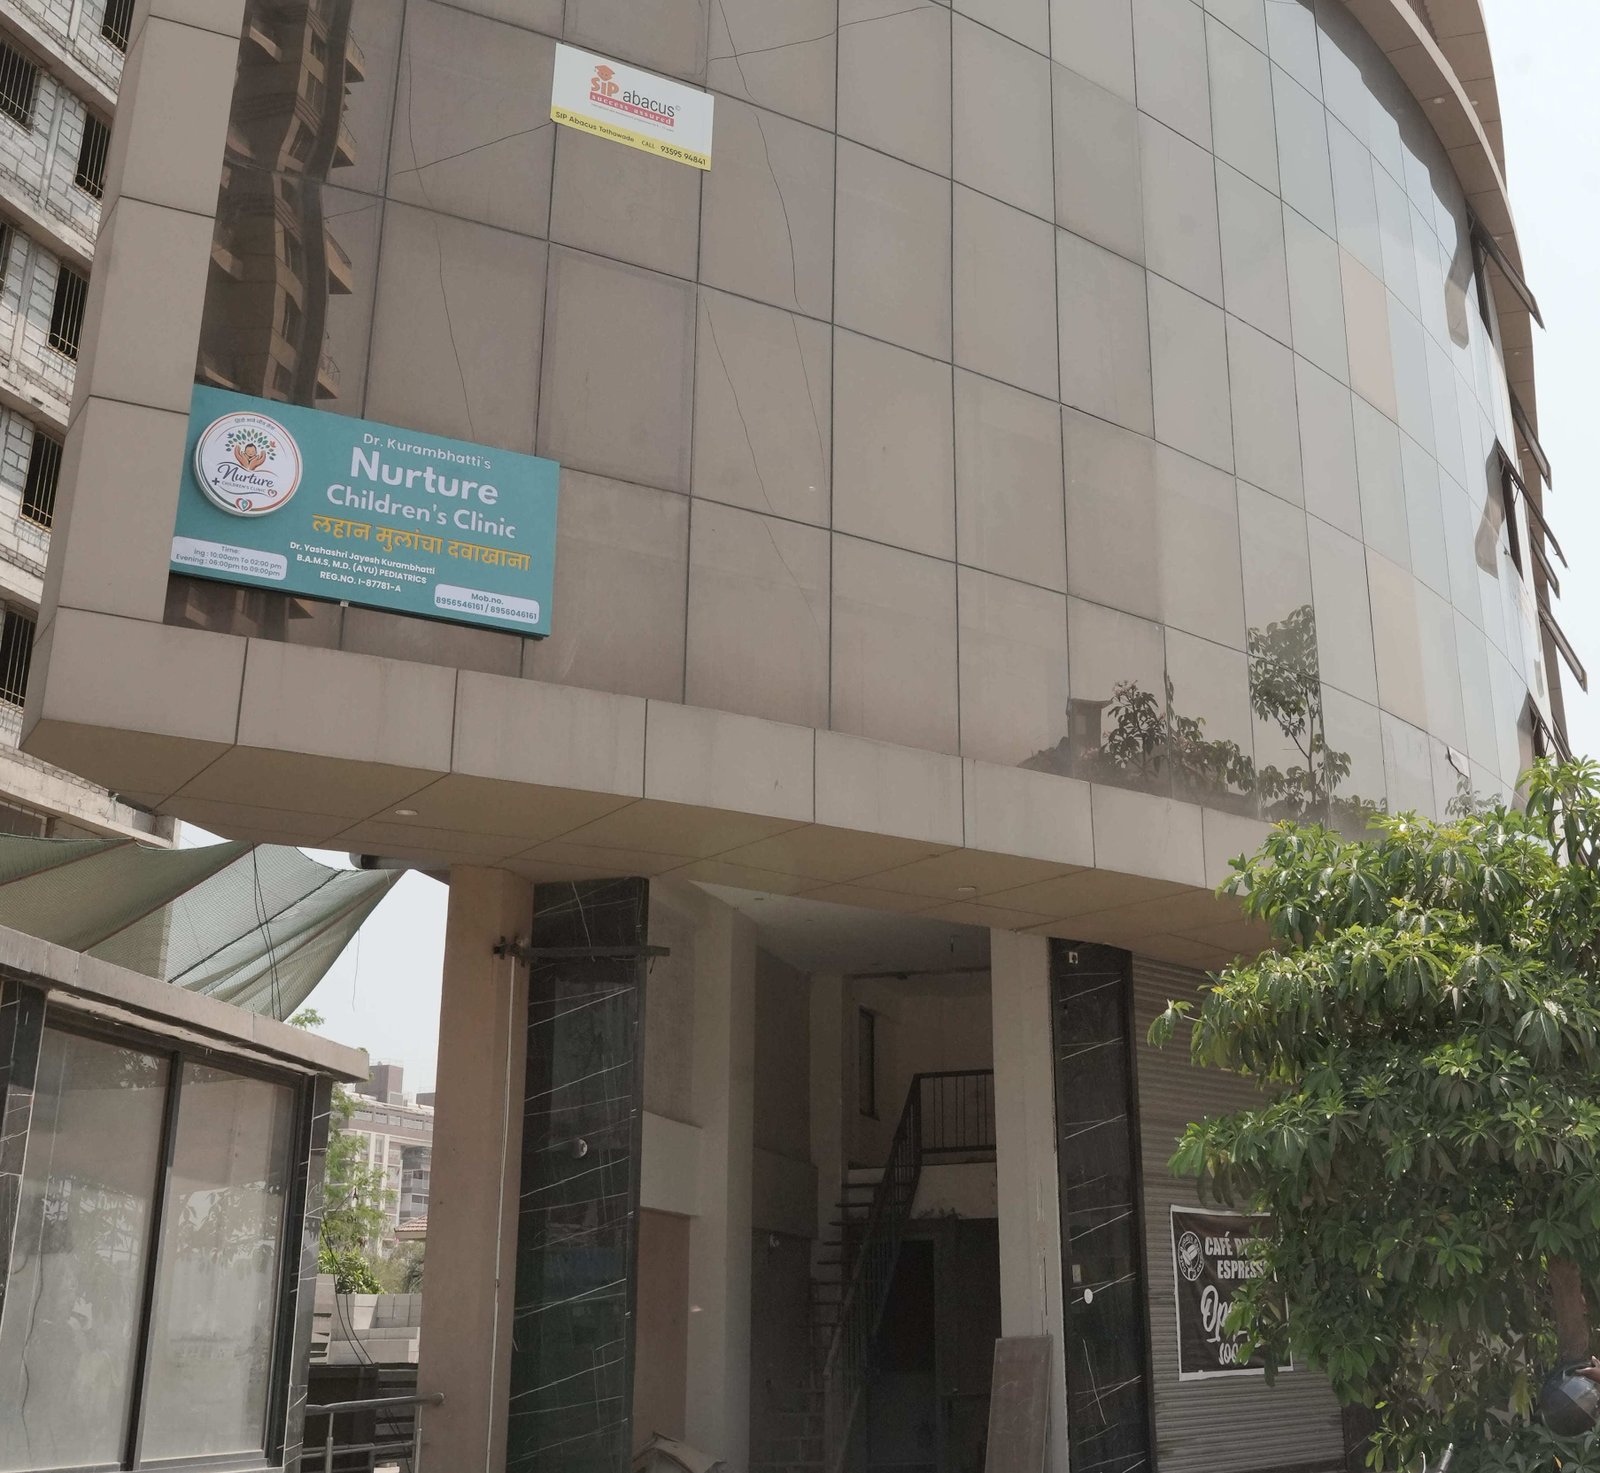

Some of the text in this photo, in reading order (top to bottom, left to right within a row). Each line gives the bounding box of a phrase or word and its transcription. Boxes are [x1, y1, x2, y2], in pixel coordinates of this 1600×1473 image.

[591, 94, 628, 111] success
[633, 108, 672, 126] assured
[622, 90, 675, 118] abacus
[555, 111, 568, 120] SIP
[568, 116, 597, 131] Abacus
[598, 126, 635, 143] Tathawade
[641, 140, 656, 150] CALL
[660, 144, 683, 159] 93595
[683, 153, 706, 166] 94841
[363, 433, 492, 470] Dr. Kurambhatti's
[217, 464, 274, 488] Nurture
[350, 446, 499, 505] Nurture
[326, 484, 516, 539] Children's Clinic
[312, 514, 532, 572] लहान मुलांचा दवाखाना
[176, 554, 204, 566] Evening
[290, 542, 436, 575] Dr. Yashashri Jayesh Kurambhatti
[332, 561, 351, 570] M.D.
[352, 563, 378, 577] (AYU)
[379, 569, 428, 584] PEDIATRICS
[320, 570, 357, 585] REG.NO.
[471, 593, 504, 605] Mob.no.
[1204, 1231, 1233, 1256] CAFÉ
[1217, 1260, 1269, 1279] ESPRESS
